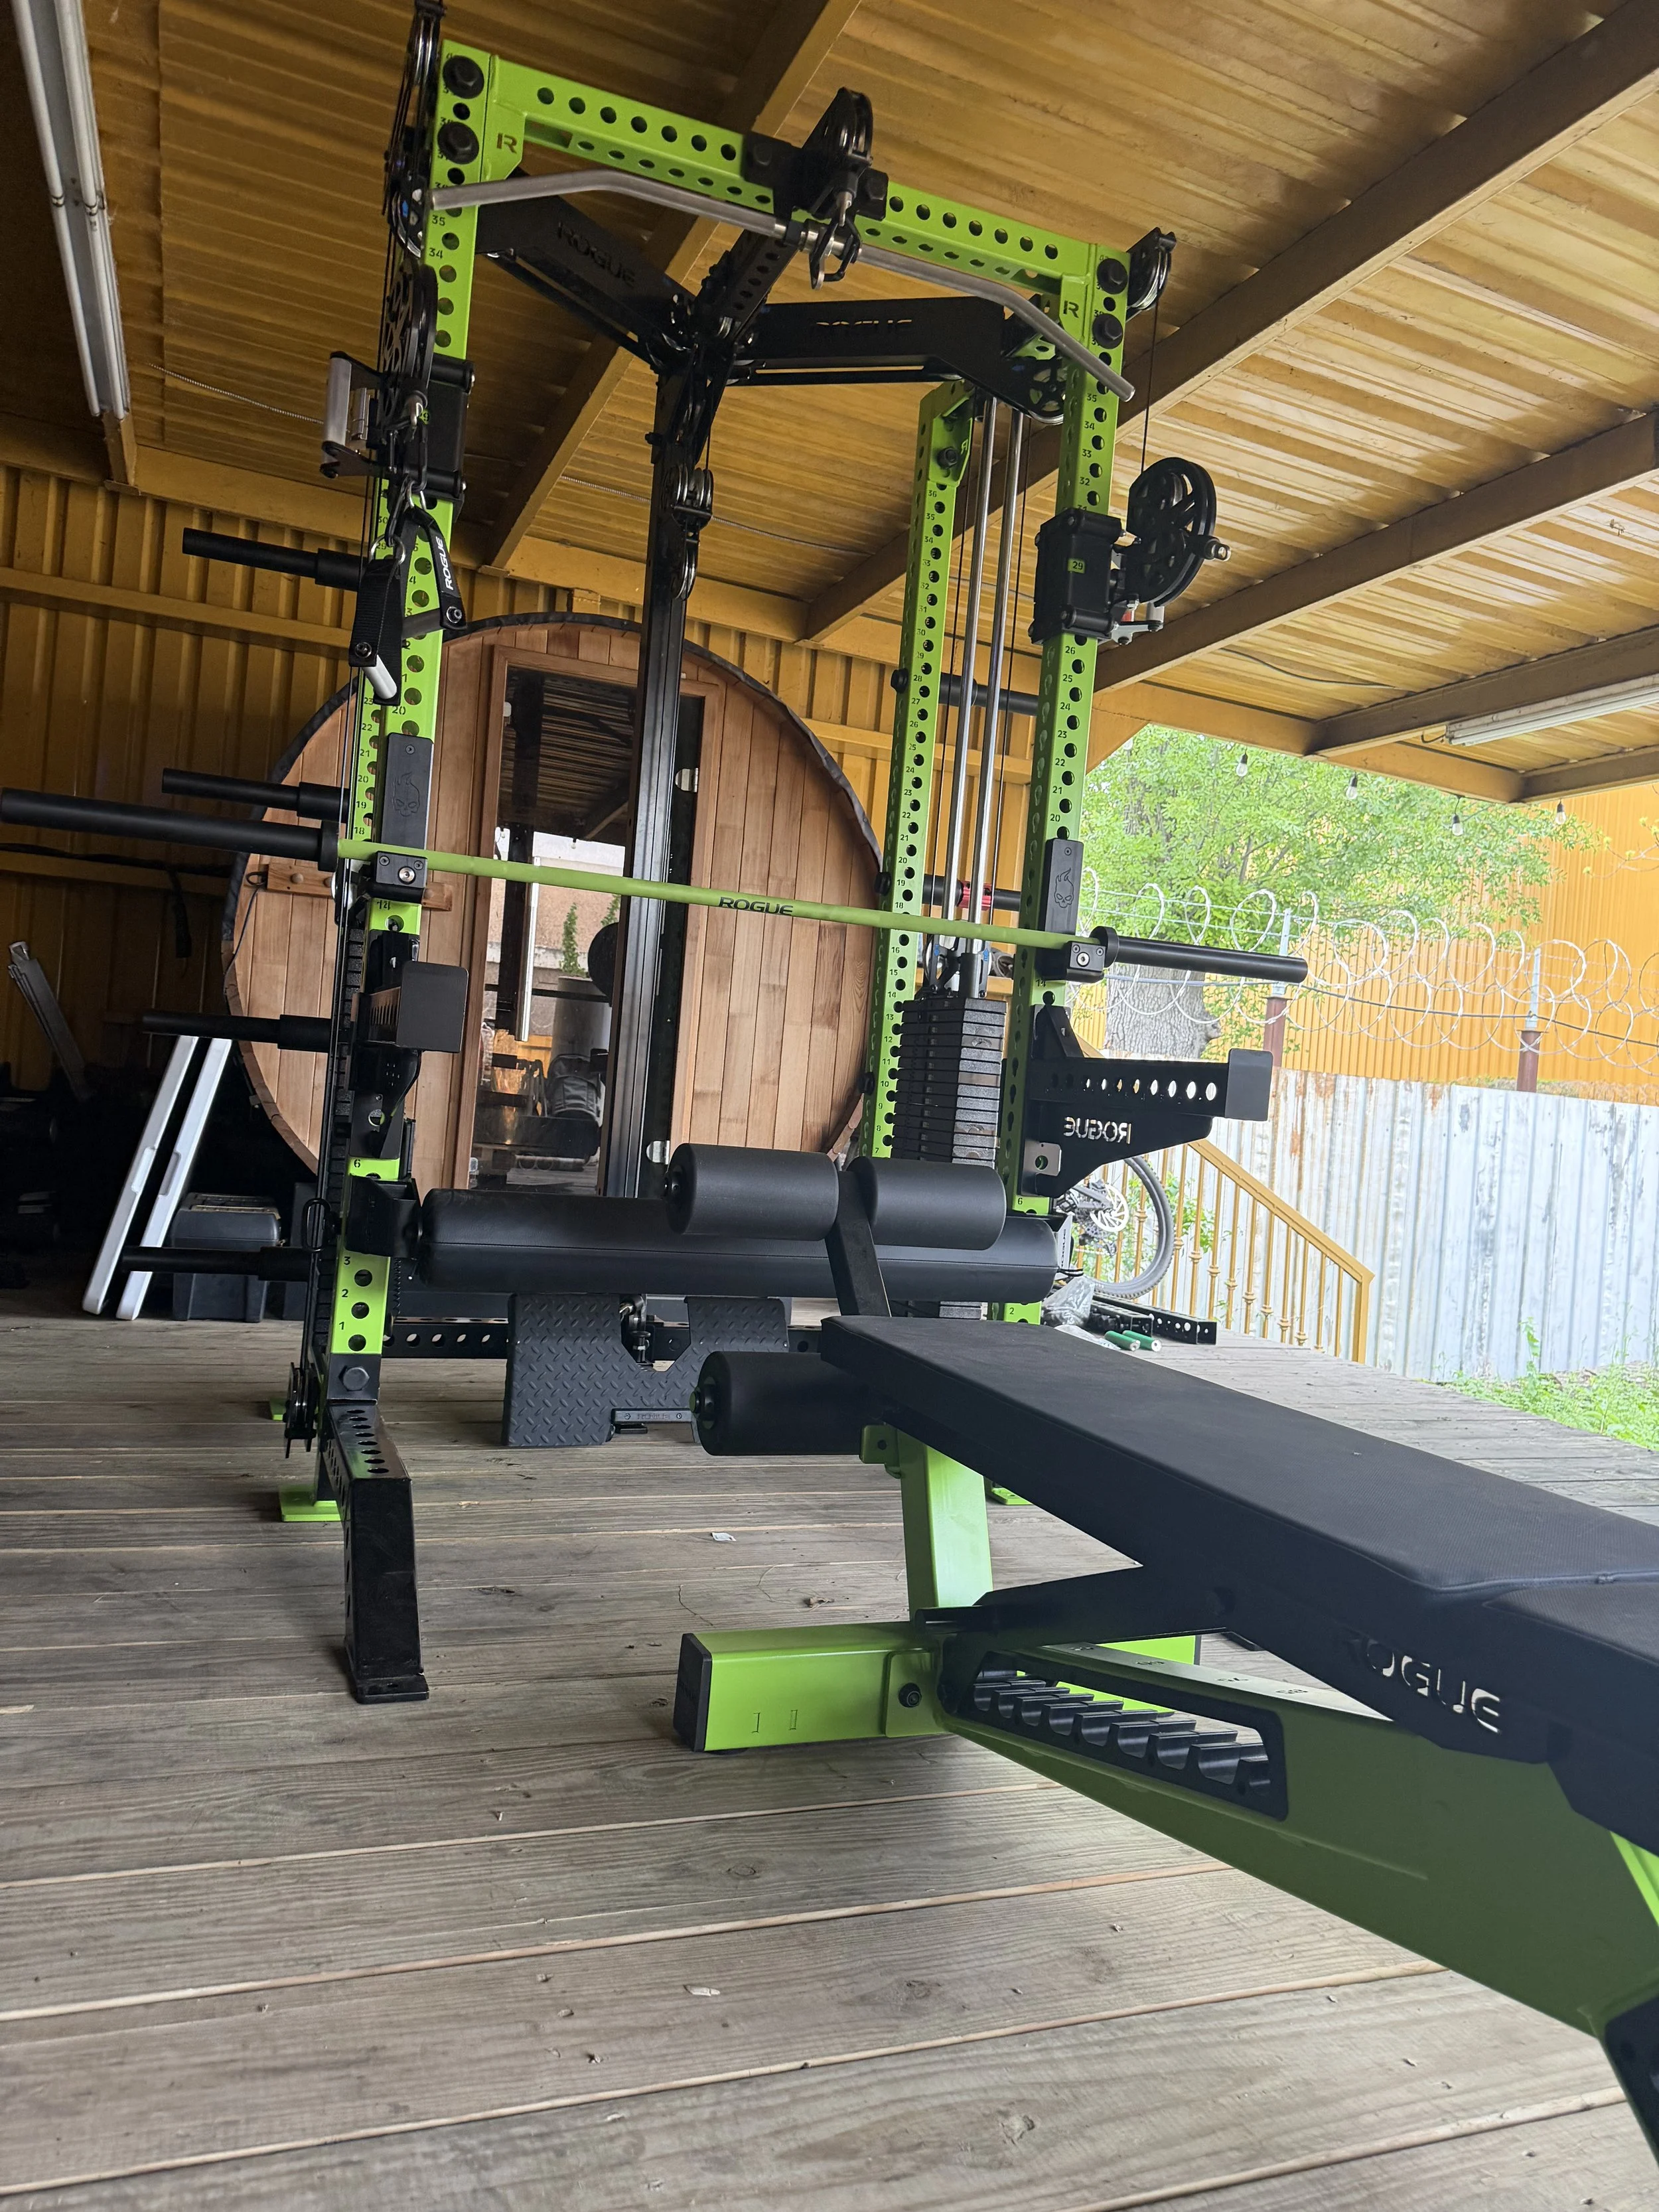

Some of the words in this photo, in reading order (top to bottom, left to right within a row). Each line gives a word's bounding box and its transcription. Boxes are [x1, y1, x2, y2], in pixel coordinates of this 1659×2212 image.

[496, 133, 518, 155] R
[432, 215, 446, 226] 35
[429, 248, 443, 259] 34
[1063, 300, 1079, 319] R
[1086, 393, 1097, 403] 35
[1084, 421, 1095, 431] 34
[1082, 449, 1092, 458] 33
[1080, 477, 1090, 486] 32
[435, 536, 454, 591] ROGUE
[1072, 561, 1084, 571] 29
[1065, 646, 1076, 655] 26
[1062, 674, 1073, 683] 25
[364, 697, 374, 705] 23
[392, 705, 406, 715] 20
[1060, 702, 1070, 711] 24
[362, 723, 372, 731] 22
[909, 720, 918, 729] 26
[1057, 730, 1067, 739] 23
[360, 749, 370, 757] 21
[1055, 758, 1066, 767] 22
[358, 774, 369, 783] 20
[1052, 786, 1062, 795] 21
[356, 800, 367, 809] 19
[1050, 814, 1060, 822] 20
[377, 899, 391, 911] 14
[719, 896, 794, 916] ROGUE
[354, 1159, 361, 1168] 6
[1017, 1197, 1023, 1206] 6
[344, 1256, 351, 1266] 3
[341, 1288, 349, 1298] 2
[338, 1321, 345, 1330] 1
